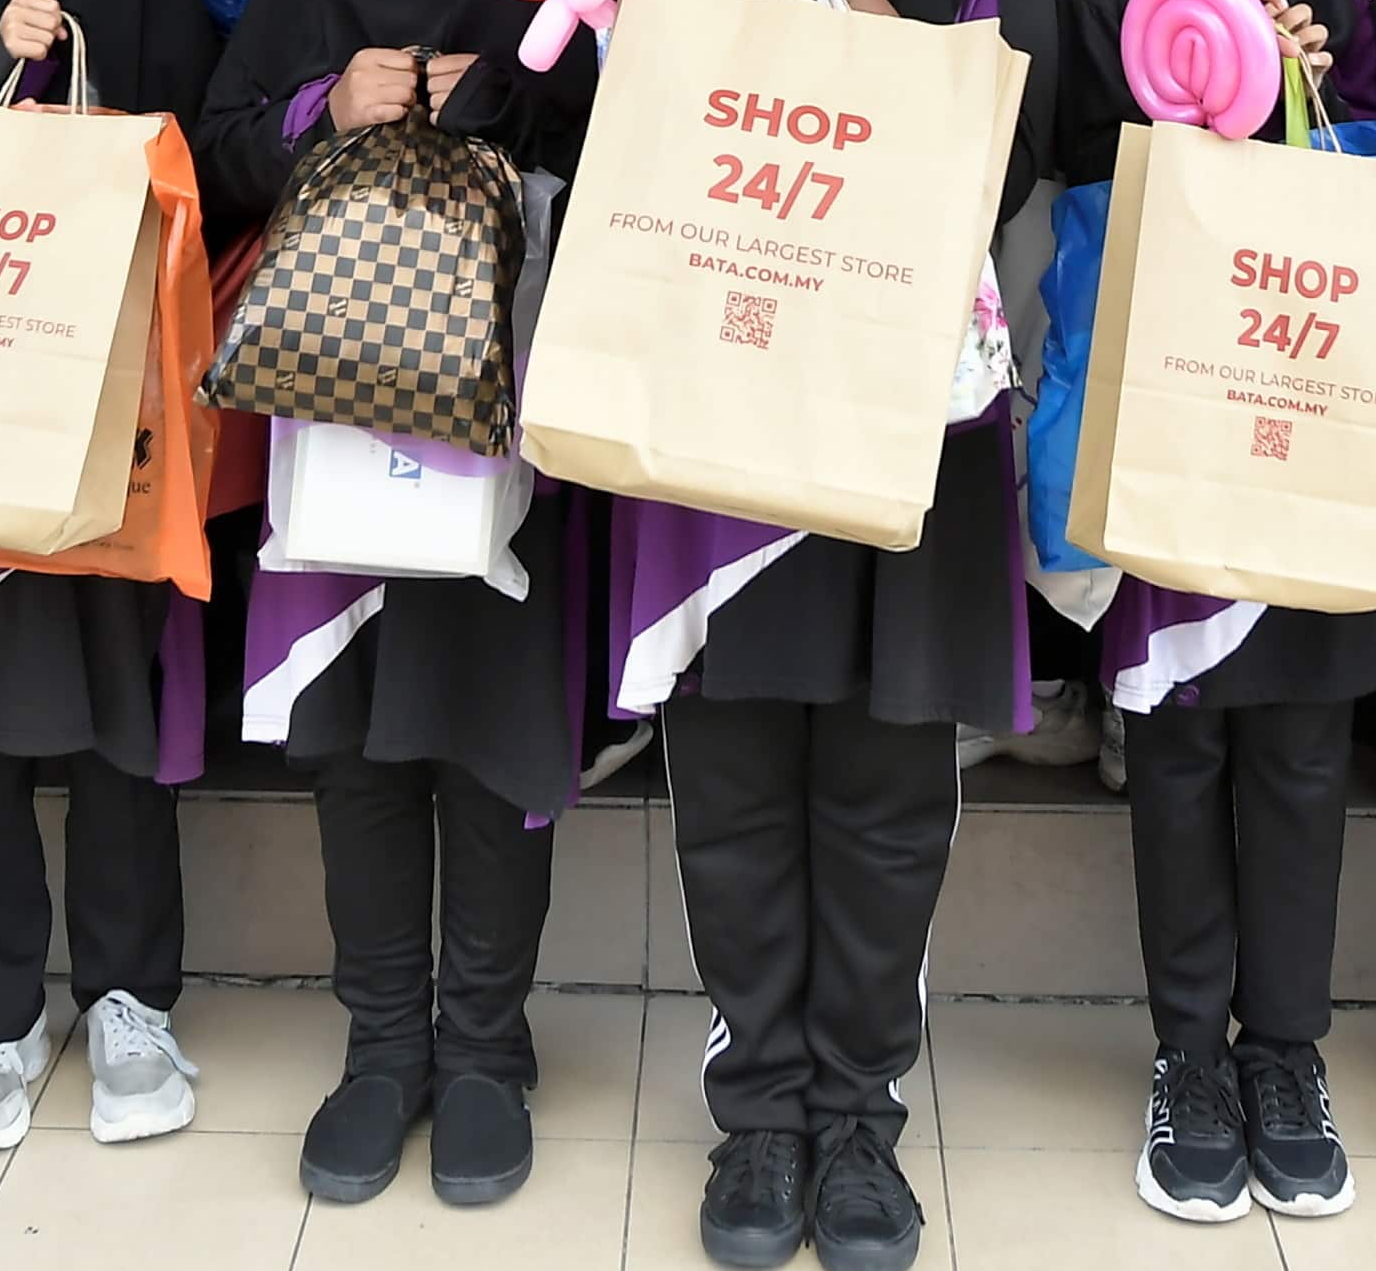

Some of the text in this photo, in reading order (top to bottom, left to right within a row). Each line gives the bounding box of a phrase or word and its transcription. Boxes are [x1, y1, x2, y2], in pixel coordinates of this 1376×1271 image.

[702, 88, 873, 151] SHOP
[706, 153, 845, 221] 24/7
[608, 212, 915, 285] FROM OUR LARGEST STORE
[688, 252, 825, 293] BATA.COM.MY
[1229, 248, 1360, 303] SHOP
[26, 318, 77, 338] STORE
[1236, 307, 1341, 360] 24/7
[1163, 355, 1215, 377] FROM
[1218, 364, 1256, 384] OUR
[1260, 371, 1337, 398] LARGEST
[1226, 389, 1329, 417] BATA.COM.MY
